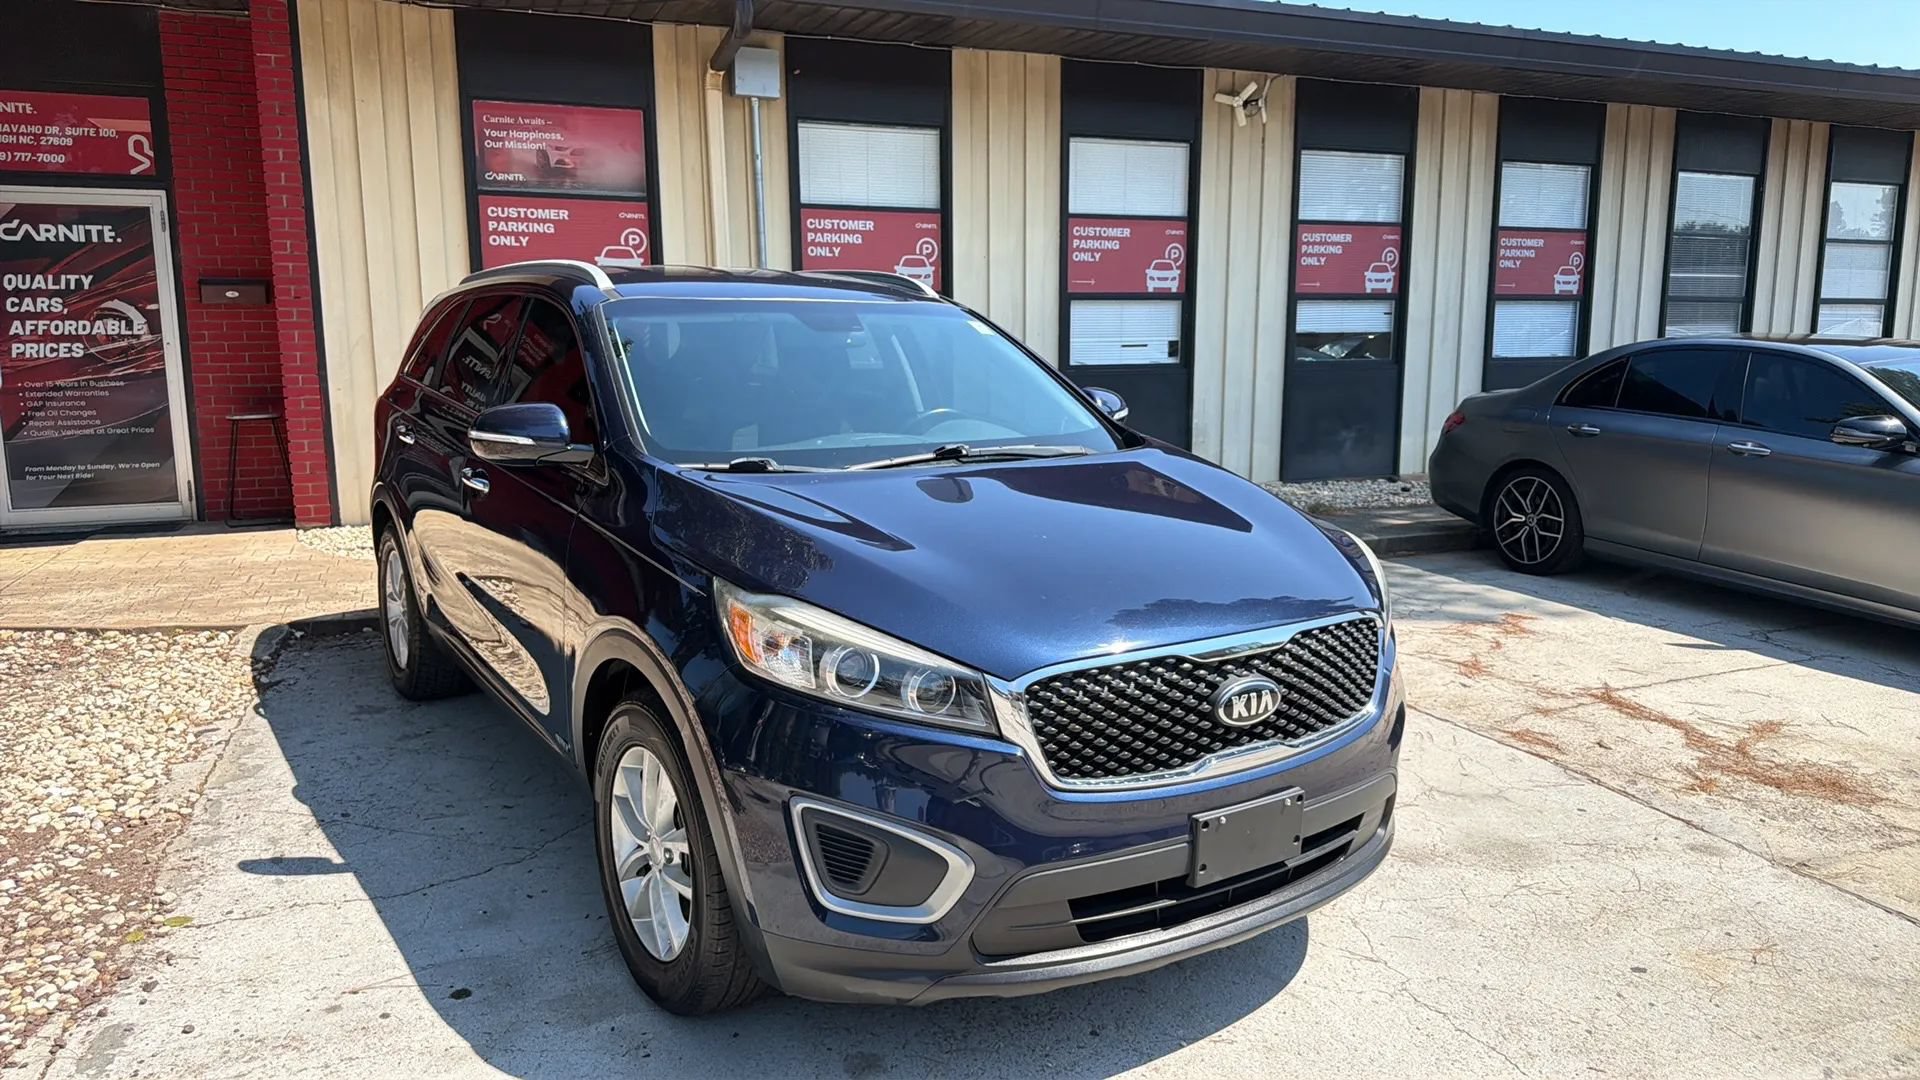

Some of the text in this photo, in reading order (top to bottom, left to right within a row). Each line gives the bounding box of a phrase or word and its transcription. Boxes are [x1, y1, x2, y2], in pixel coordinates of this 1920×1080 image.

[483, 114, 515, 124] Carnite
[516, 116, 545, 125] Awaits
[0, 123, 119, 139] AVAHO DR, SUITE 100,
[483, 128, 564, 141] Your Happiness,
[18, 135, 37, 146] NC,
[40, 136, 73, 146] 27609
[484, 139, 546, 150] Our Mission!
[14, 152, 65, 164] 717-7000
[487, 206, 569, 220] CUSTOMER
[488, 221, 555, 234] PARKING
[807, 218, 874, 231] CUSTOMER
[1072, 226, 1131, 237] CUSTOMER
[489, 235, 529, 247] ONLY
[807, 232, 862, 244] PARKING
[1301, 233, 1352, 242] CUSTOMER
[1500, 238, 1544, 247] CUSTOMER
[1072, 239, 1120, 250] PARKING
[1301, 245, 1343, 254] PARKING
[807, 246, 841, 257] ONLY
[1072, 252, 1101, 262] ONLY
[1500, 249, 1535, 257] PARKING
[1301, 257, 1327, 265] ONLY
[1499, 260, 1521, 268] ONLY
[3, 274, 94, 292] QUALITY
[6, 297, 68, 315] CARS,
[9, 319, 146, 336] AFFORDABLE
[11, 342, 86, 359] PRICES
[54, 380, 78, 388] Years
[26, 400, 44, 408] GAP
[60, 409, 97, 418] Changes
[29, 420, 55, 428] Repair
[46, 464, 76, 472] Monday
[87, 463, 117, 471] Sunday,
[141, 462, 160, 470] Open
[1231, 689, 1274, 719] KIA
